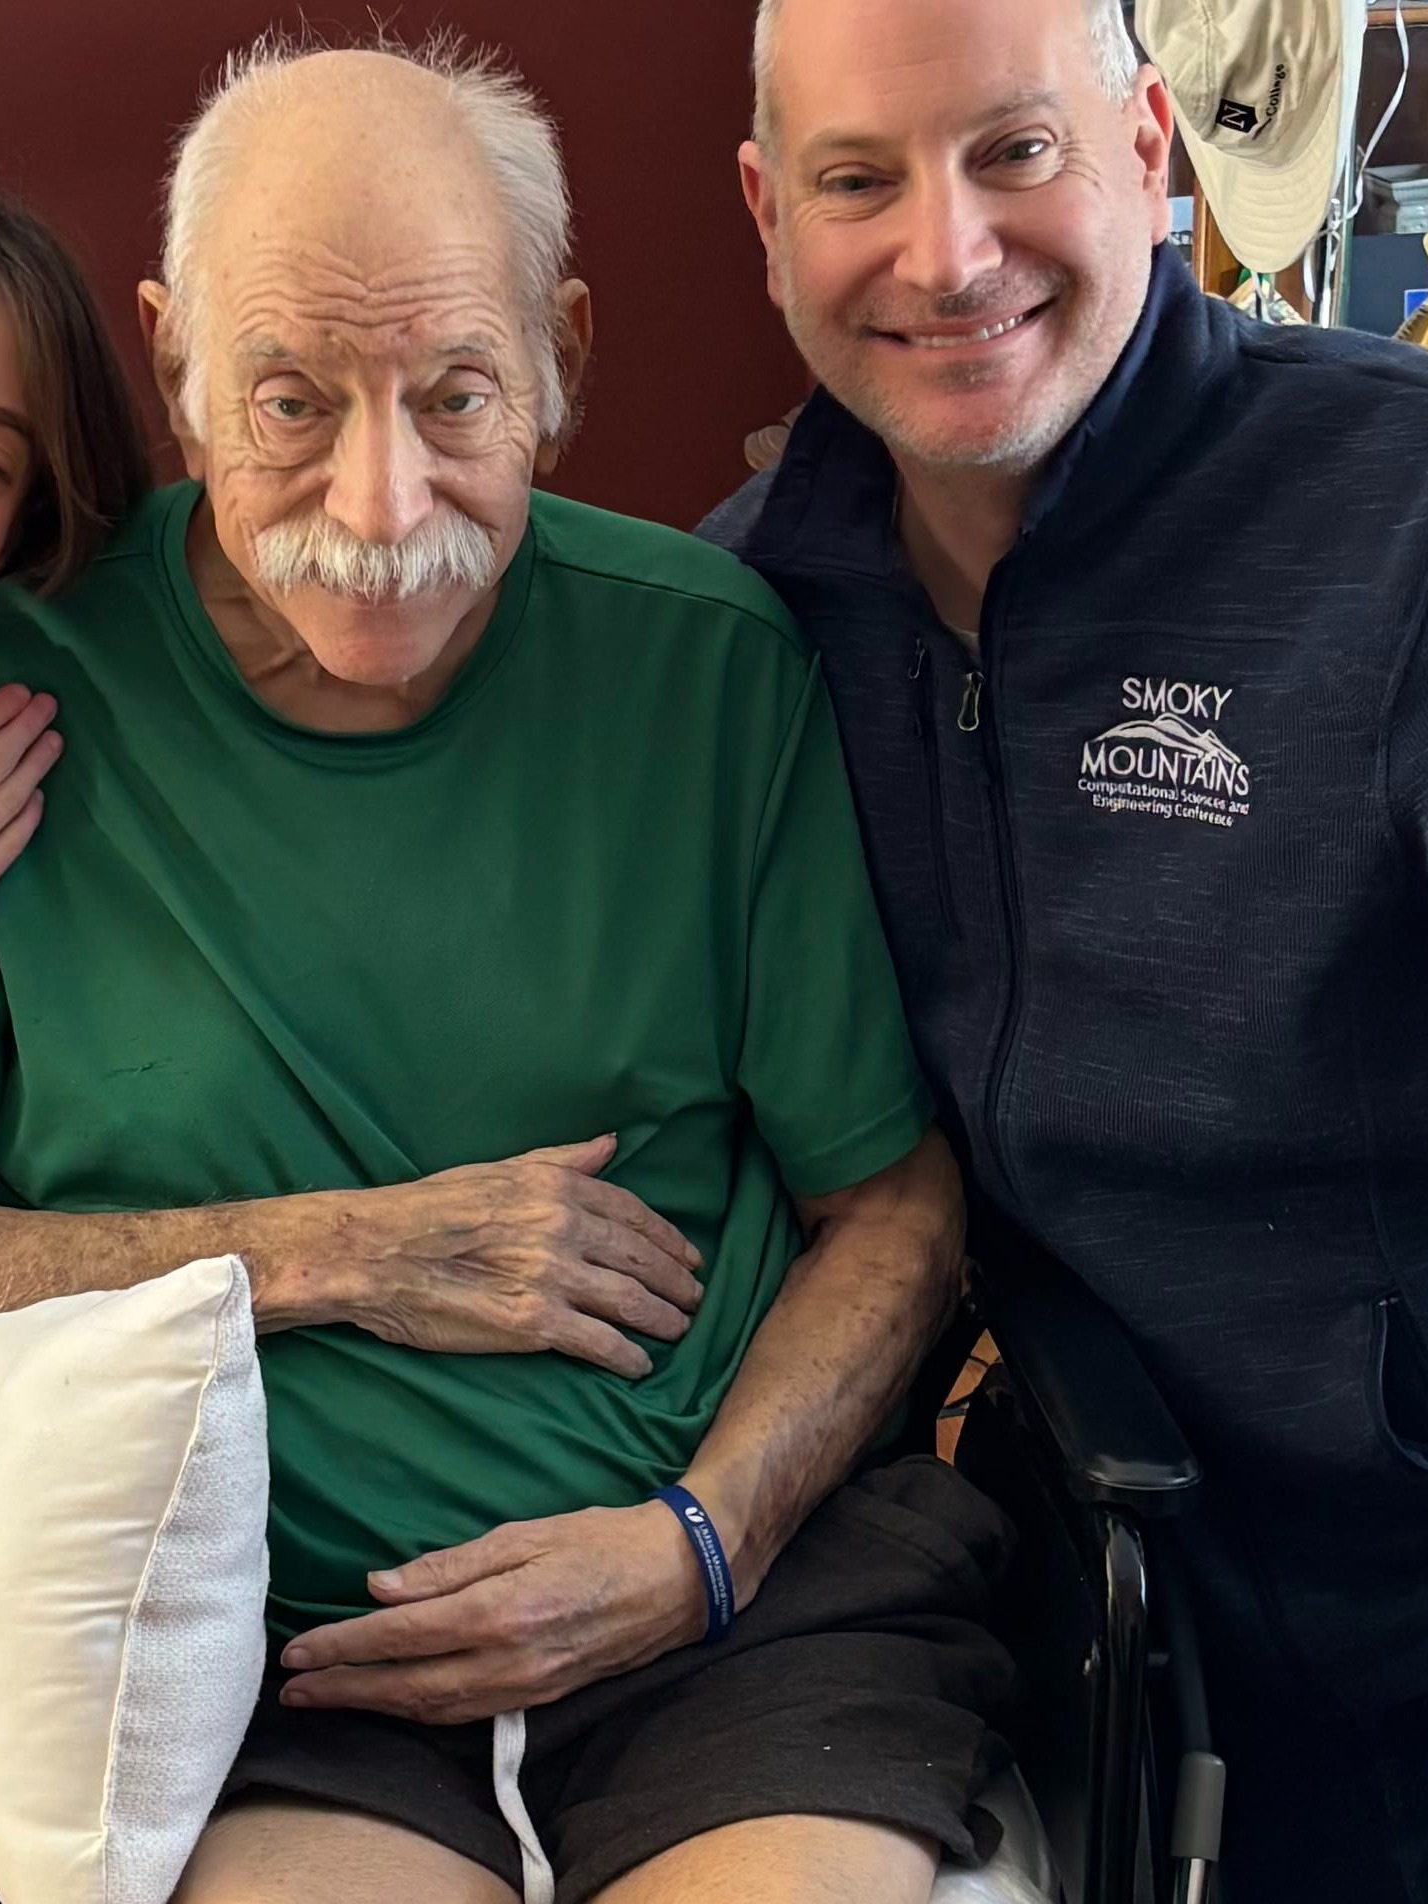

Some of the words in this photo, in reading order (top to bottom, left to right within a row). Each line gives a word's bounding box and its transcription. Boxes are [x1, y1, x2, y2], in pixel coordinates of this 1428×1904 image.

[1266, 63, 1286, 117] College
[1222, 103, 1248, 129] N
[1122, 677, 1233, 721] SMOKY
[1080, 741, 1250, 797] MOUNTAINS
[1078, 778, 1180, 801] Computational
[1228, 800, 1250, 816] and
[1092, 794, 1173, 819] Engineering
[1174, 803, 1235, 827] Conference
